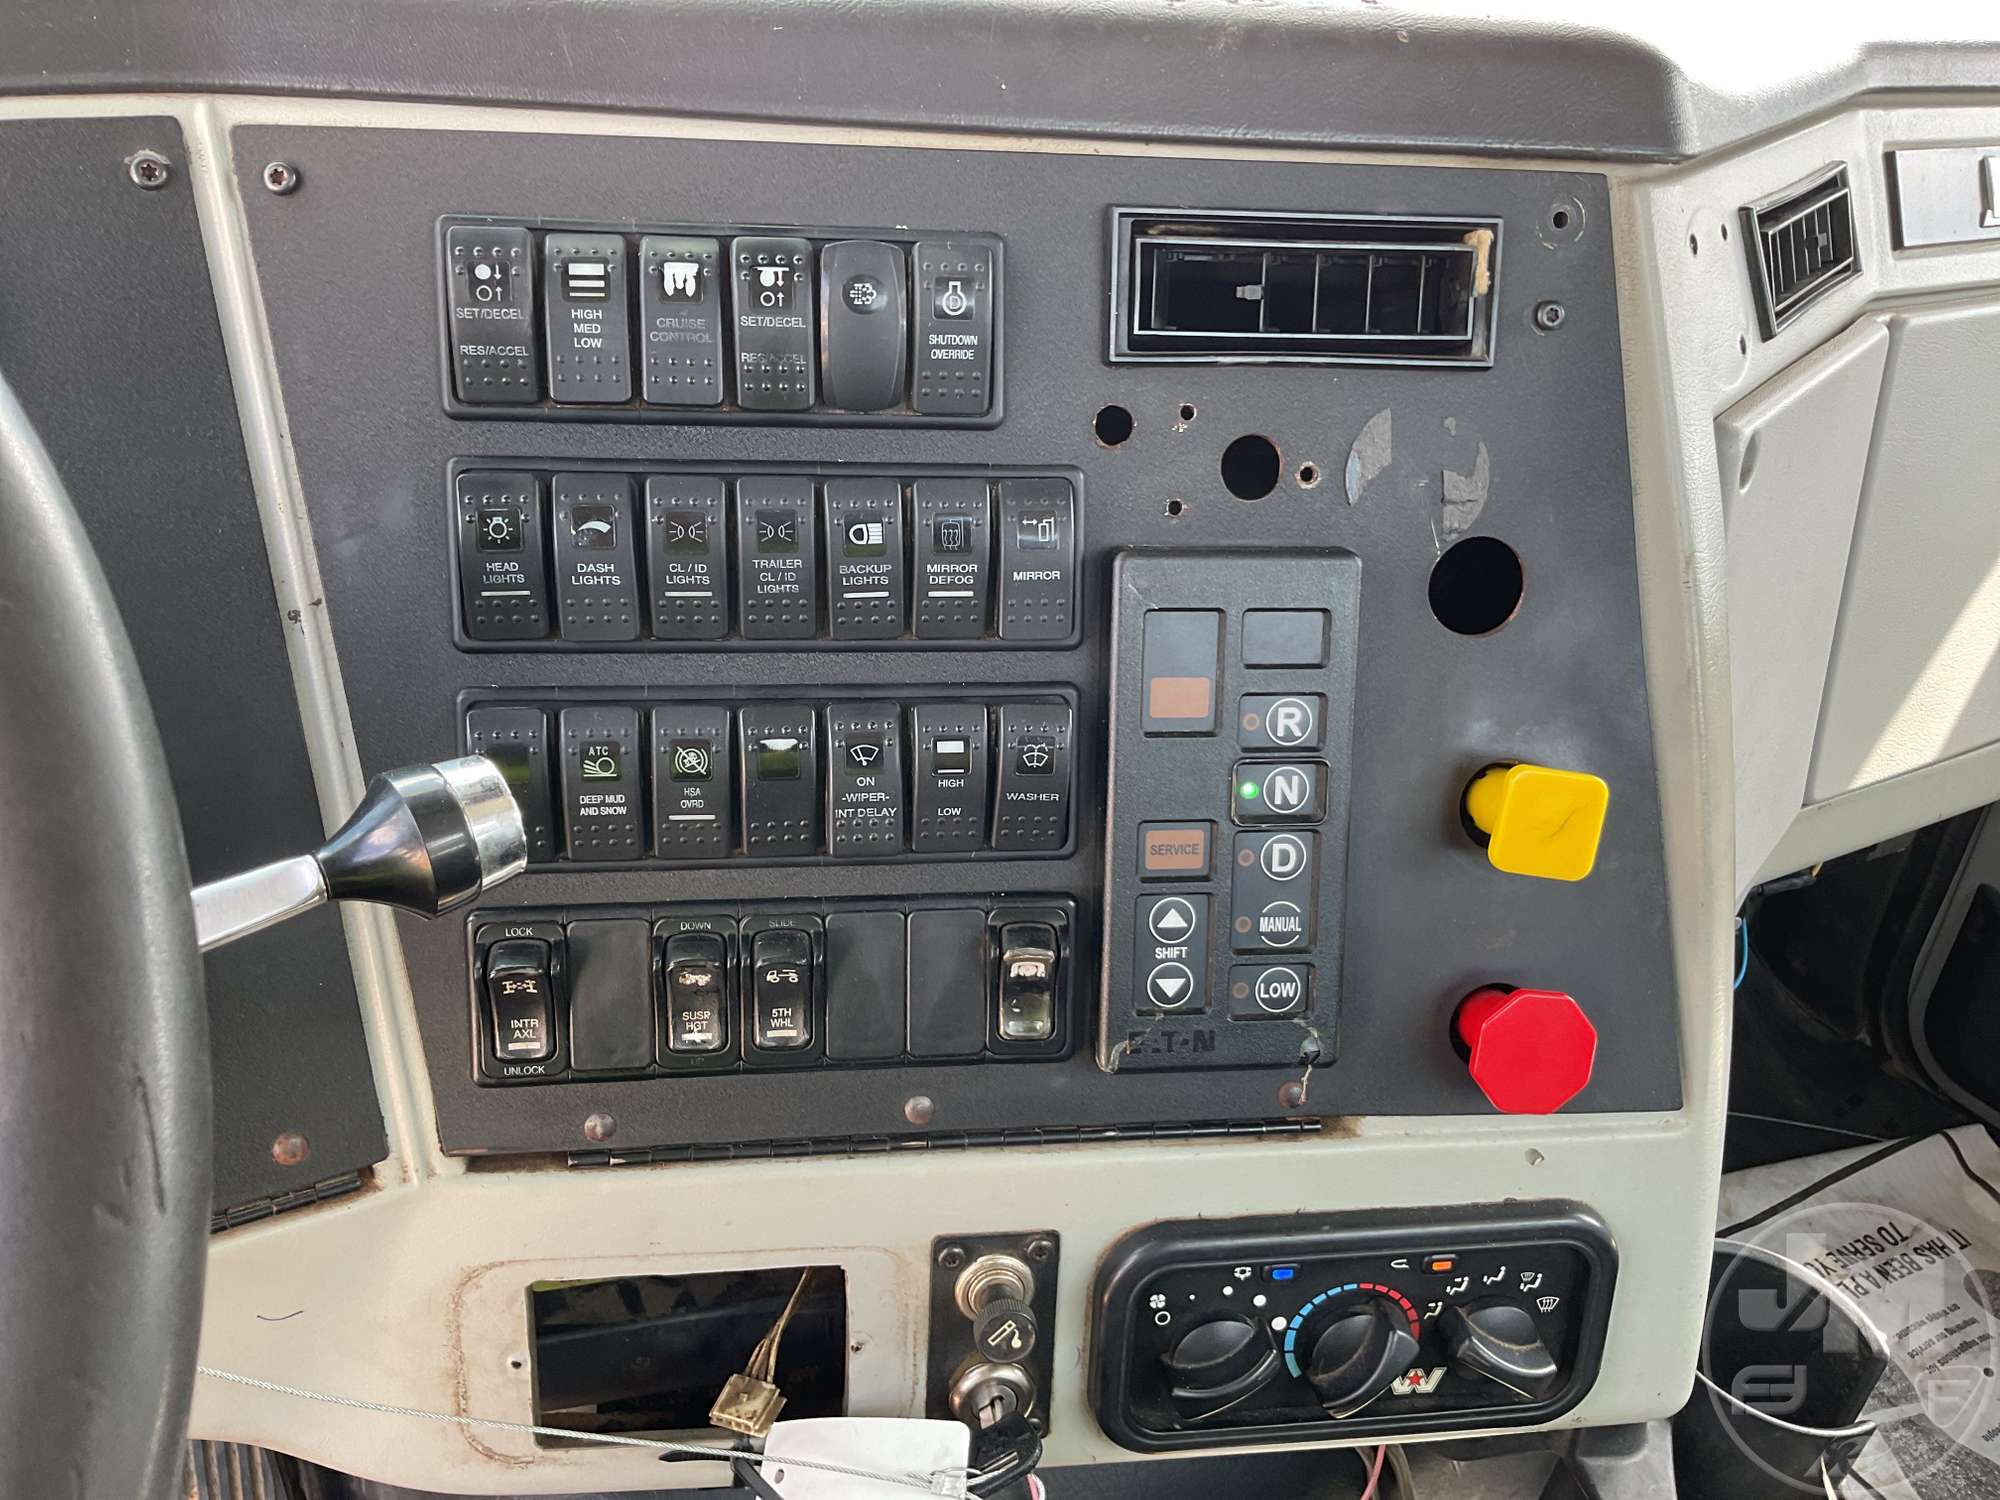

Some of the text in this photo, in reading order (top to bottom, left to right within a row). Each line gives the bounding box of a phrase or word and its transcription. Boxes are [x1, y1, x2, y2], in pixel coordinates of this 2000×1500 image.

[455, 307, 526, 321] SET/DECEL
[572, 309, 602, 319] HIGH
[657, 318, 705, 329] CRUISE
[741, 316, 806, 328] SET/DECEL
[574, 323, 601, 333] MED
[650, 331, 712, 343] CONTROL
[929, 335, 977, 345] SHUTDOWN
[574, 338, 602, 348] LOW
[460, 345, 528, 356] RES/ACCEL
[931, 349, 974, 359] OVERRIDE
[486, 562, 519, 573] HEAD
[577, 564, 614, 572] DASH
[669, 564, 684, 572] CL
[752, 559, 802, 568] TRAILER
[840, 565, 892, 576] BACKUP
[927, 564, 977, 575] MIRROR
[483, 574, 525, 583] LIGHTS
[572, 576, 620, 585] LIGHTS
[666, 575, 710, 584] LIGHTS
[760, 572, 775, 581] CL
[843, 577, 888, 585] LIGHTS
[929, 576, 973, 584] DEFOG
[1014, 571, 1060, 581] MIRROR
[758, 585, 799, 593] LIGHTS
[1276, 706, 1303, 738] R
[857, 777, 874, 786] ON
[938, 779, 964, 787] HIGH
[1273, 774, 1300, 806] N
[580, 795, 626, 805] DEEP MUD
[580, 806, 627, 815] AND SNOW
[857, 808, 897, 819] DELAY
[1149, 842, 1201, 856] SERVICE
[1271, 842, 1299, 874] D
[681, 922, 711, 930] DOWN
[1260, 917, 1301, 932] MANUAL
[506, 928, 533, 936] LOCK
[1155, 947, 1188, 959] SHIFT
[1258, 981, 1297, 999] LOW
[771, 1008, 791, 1018] 5TH
[771, 1017, 796, 1029] WHL
[513, 1029, 536, 1039] AXL
[504, 1066, 545, 1075] UNLOCK
[1877, 1222, 1909, 1246] TO
[1947, 1228, 1972, 1250] IT
[1826, 1234, 1886, 1269] SERVE
[1913, 1236, 1955, 1264] HAS
[1872, 1252, 1923, 1284] BEEN
[1859, 1269, 1882, 1289] A
